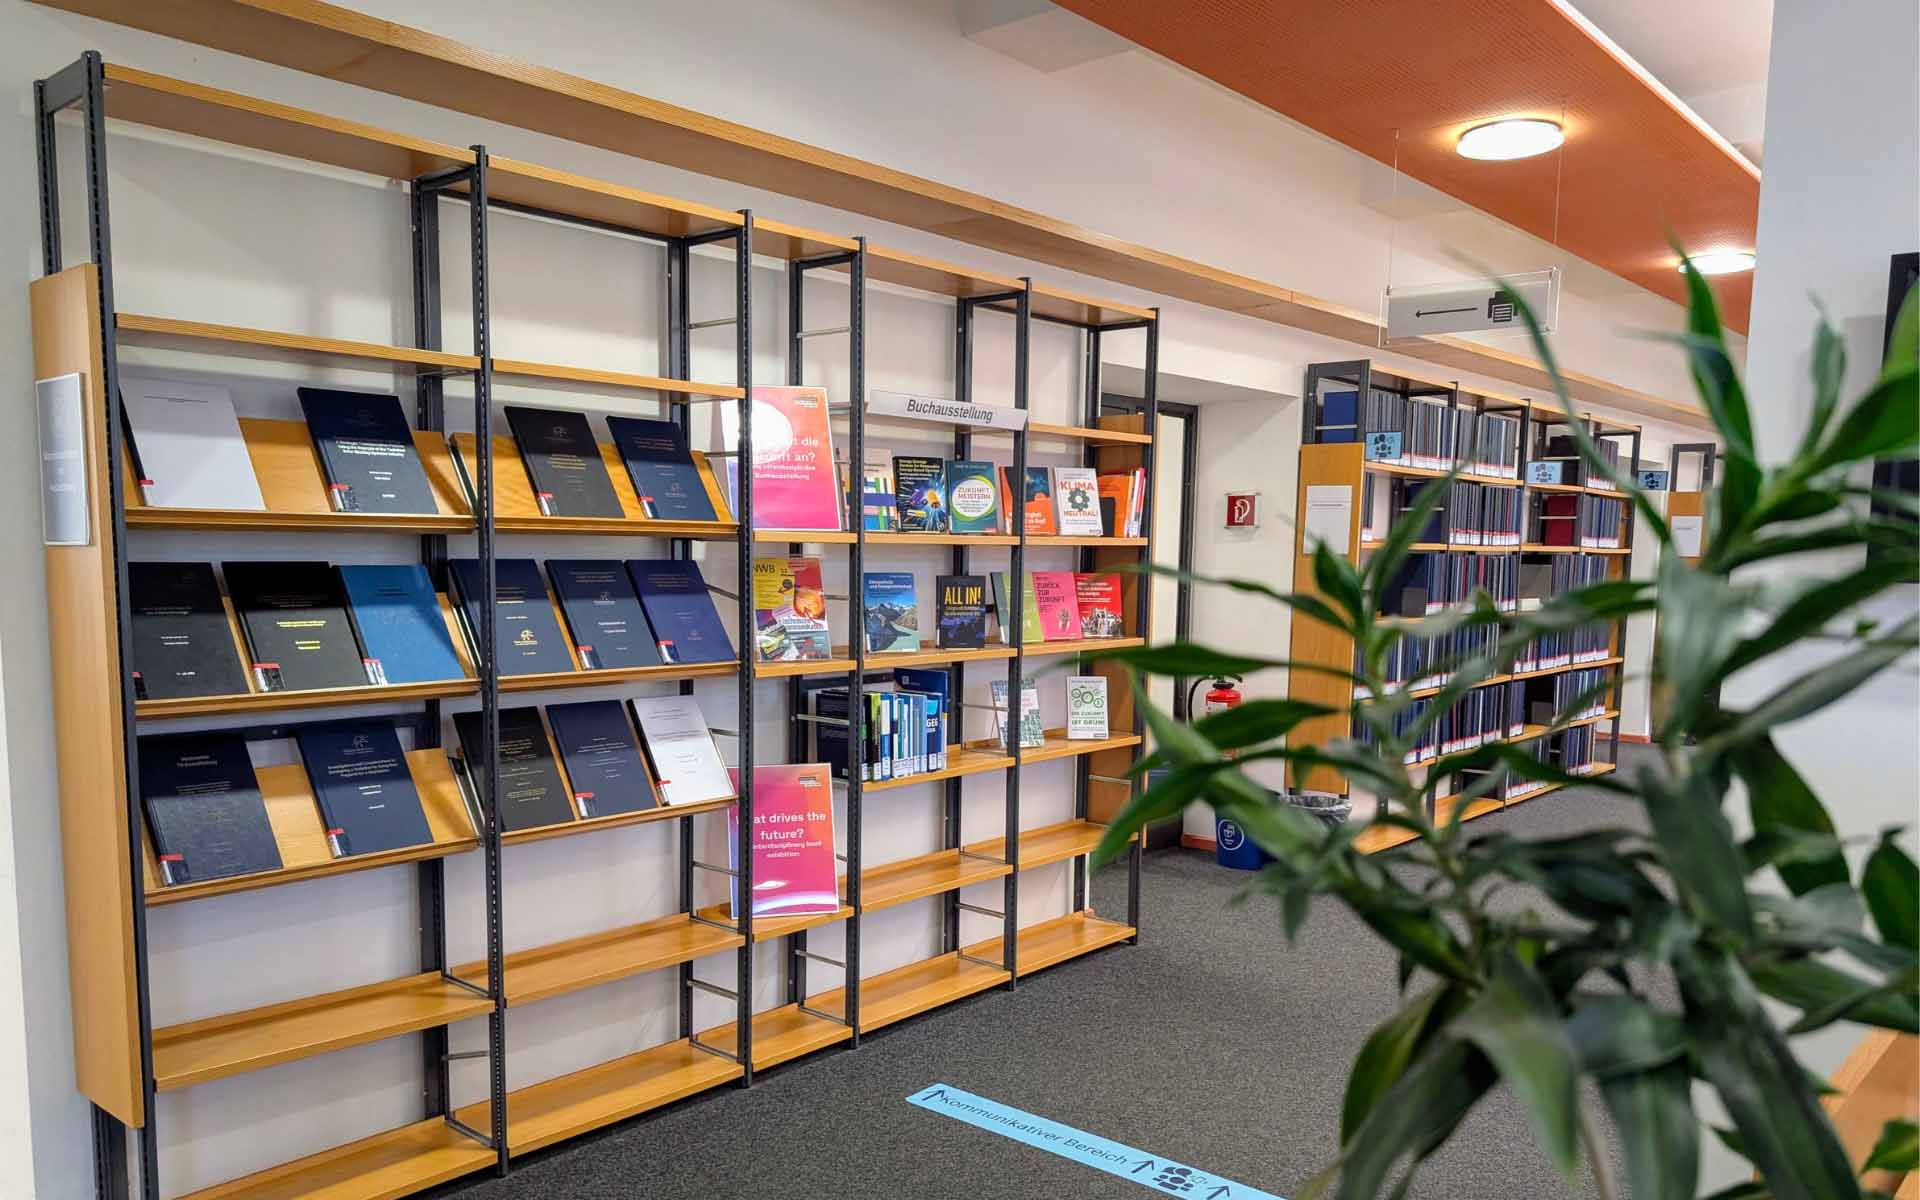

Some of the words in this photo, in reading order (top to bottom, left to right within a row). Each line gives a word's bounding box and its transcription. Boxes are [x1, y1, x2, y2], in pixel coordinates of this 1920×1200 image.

[907, 399, 993, 423] Buchausstellung
[801, 436, 819, 447] die
[797, 451, 816, 463] an?
[1060, 480, 1095, 490] KLIMA
[944, 586, 963, 605] ALL
[965, 586, 982, 605] IN!
[769, 811, 804, 824] drives
[807, 811, 827, 821] the
[760, 828, 804, 840] future?
[1063, 1137, 1128, 1165] Bereich
